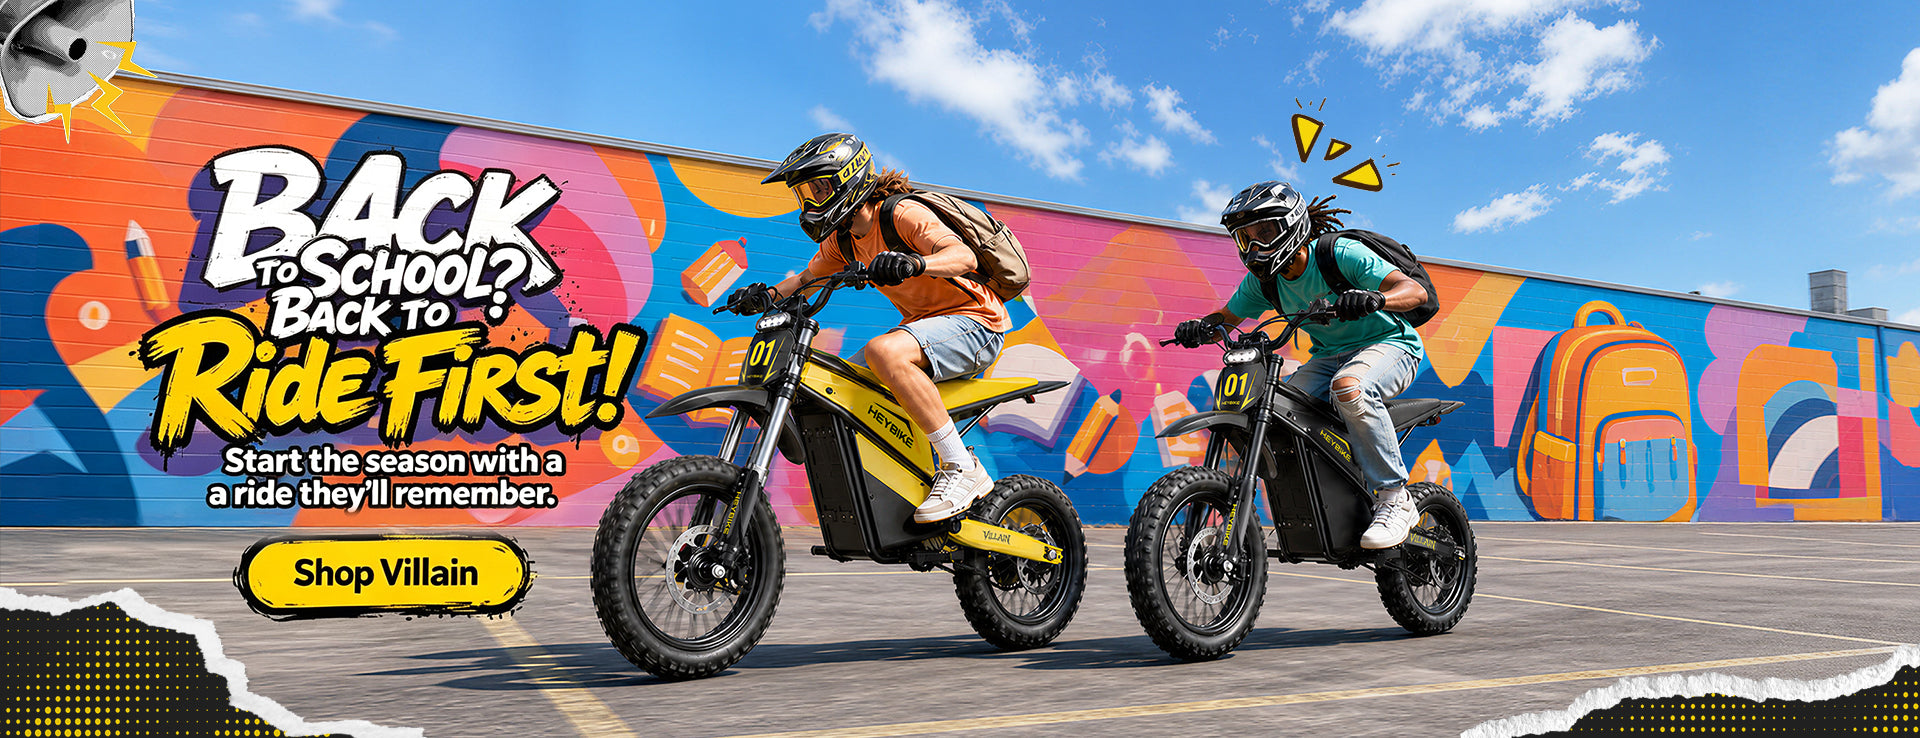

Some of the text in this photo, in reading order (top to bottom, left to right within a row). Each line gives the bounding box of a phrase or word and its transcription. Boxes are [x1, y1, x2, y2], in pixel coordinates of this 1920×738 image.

[750, 339, 776, 366] 01
[1224, 372, 1249, 397] 01
[867, 404, 914, 449] HEYBIKE
[1319, 429, 1352, 462] HEYBIKE
[722, 491, 742, 535] HEYBIKE
[1223, 503, 1238, 546] HEYBIKE
[983, 530, 1011, 545] VILLAIN
[1410, 533, 1437, 551] VILLAIN
